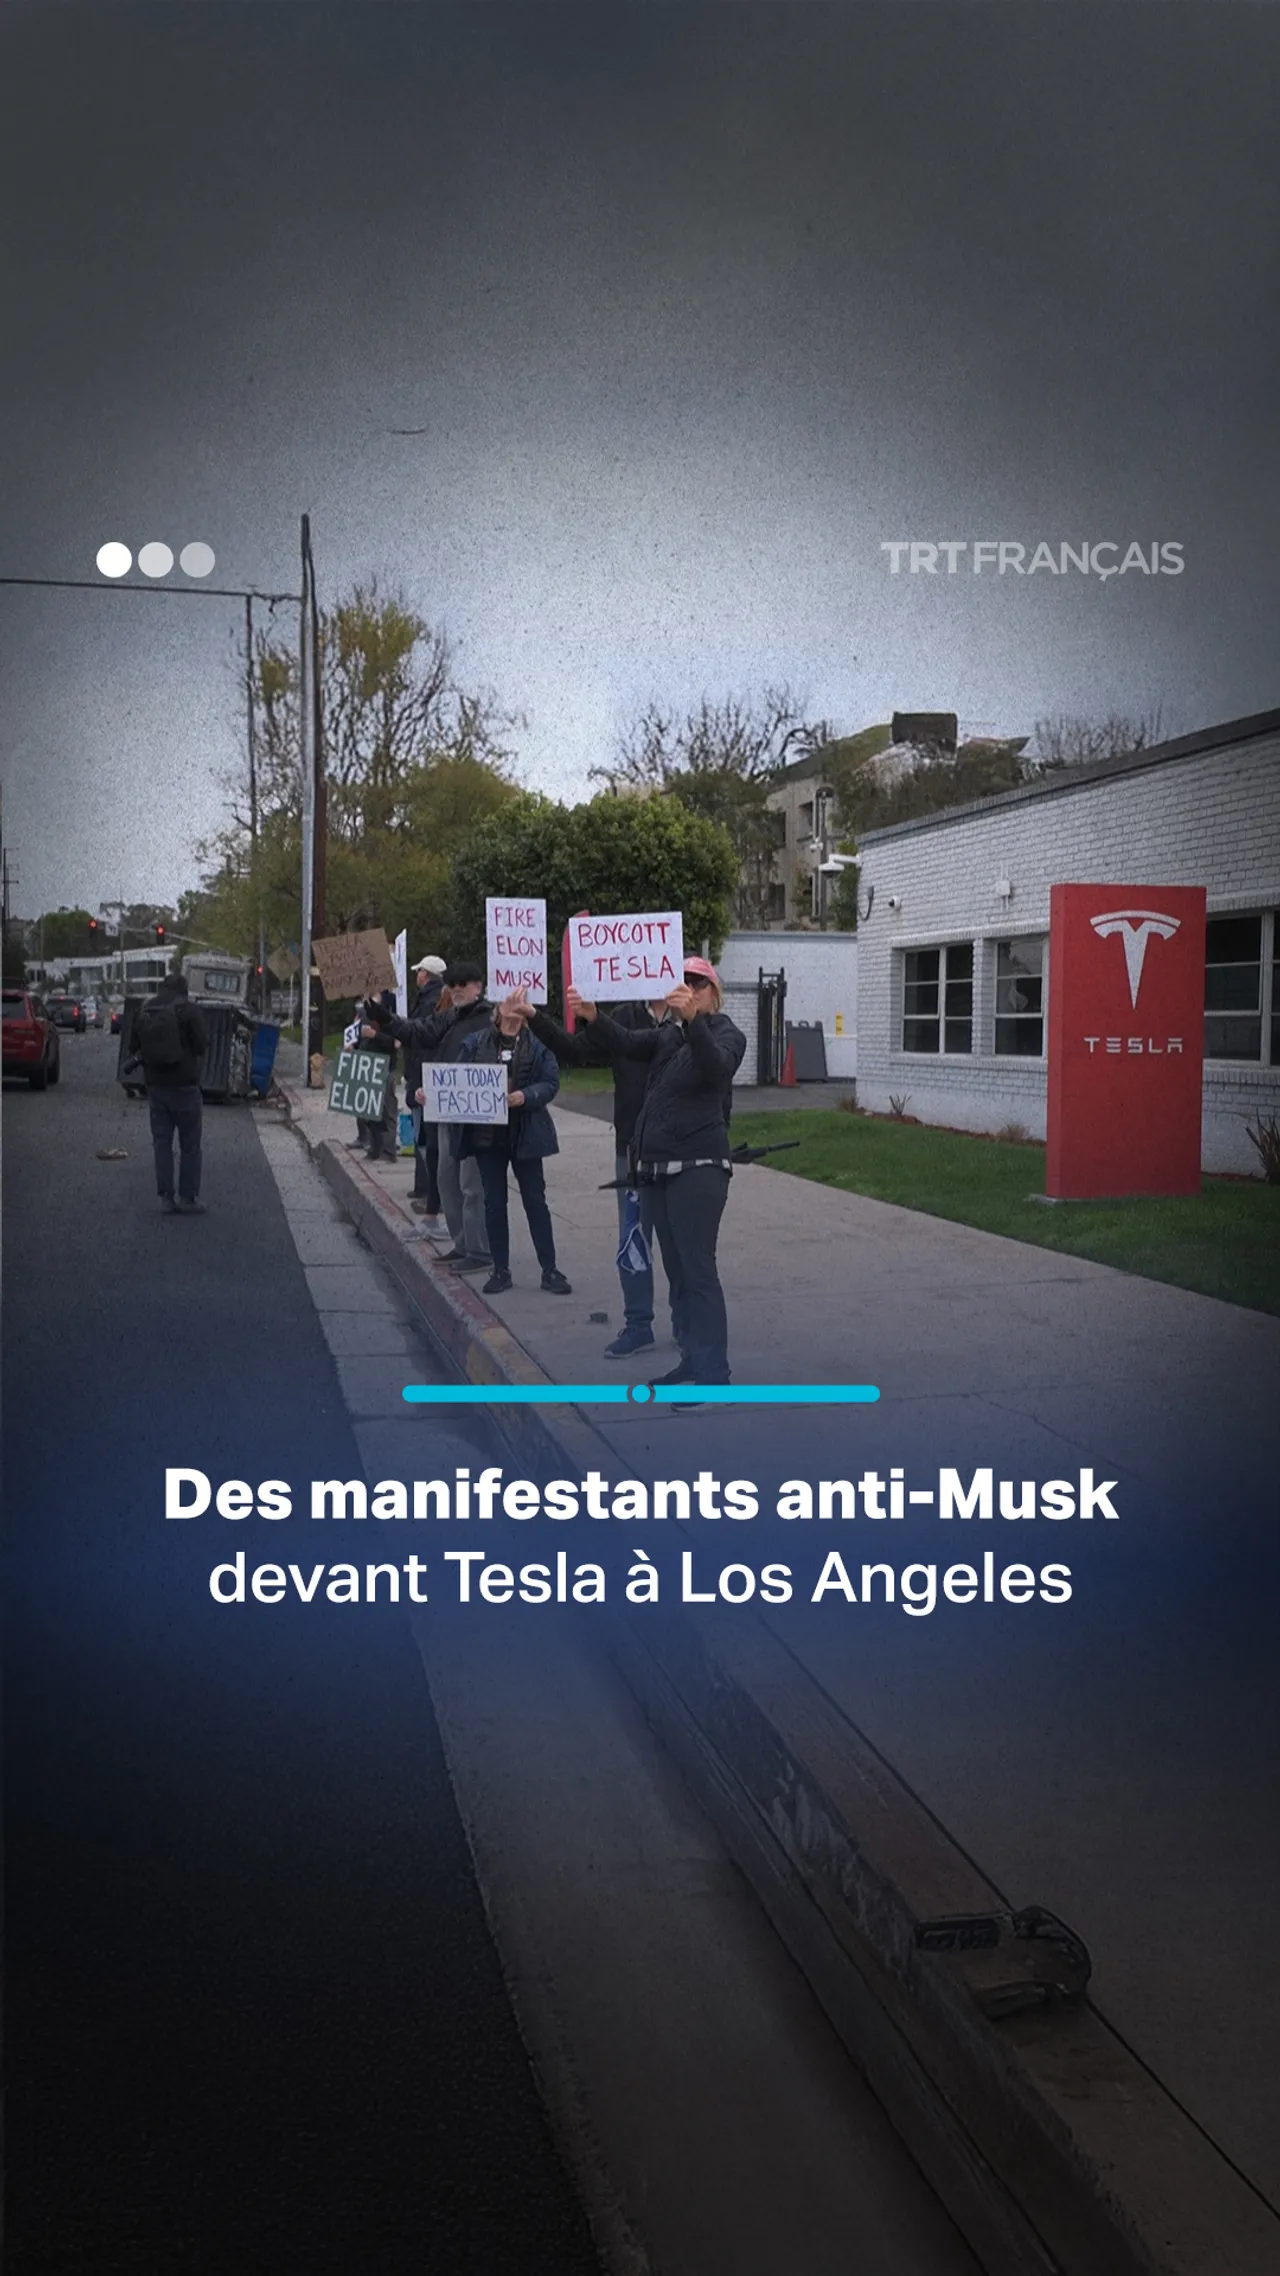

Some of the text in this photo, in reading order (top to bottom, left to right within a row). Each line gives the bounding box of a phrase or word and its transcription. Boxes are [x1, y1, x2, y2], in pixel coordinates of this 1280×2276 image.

[494, 907, 536, 928] FIRE
[496, 935, 544, 956] ELON
[578, 922, 671, 948] BOYCOTT
[495, 969, 545, 990] MUSK
[594, 955, 675, 982] TESLA
[1084, 1036, 1183, 1054] TESLA
[337, 1051, 386, 1085] FIRE
[432, 1068, 502, 1087] NOT TODAY
[330, 1081, 383, 1116] ELON
[437, 1090, 507, 1116] FASCISM
